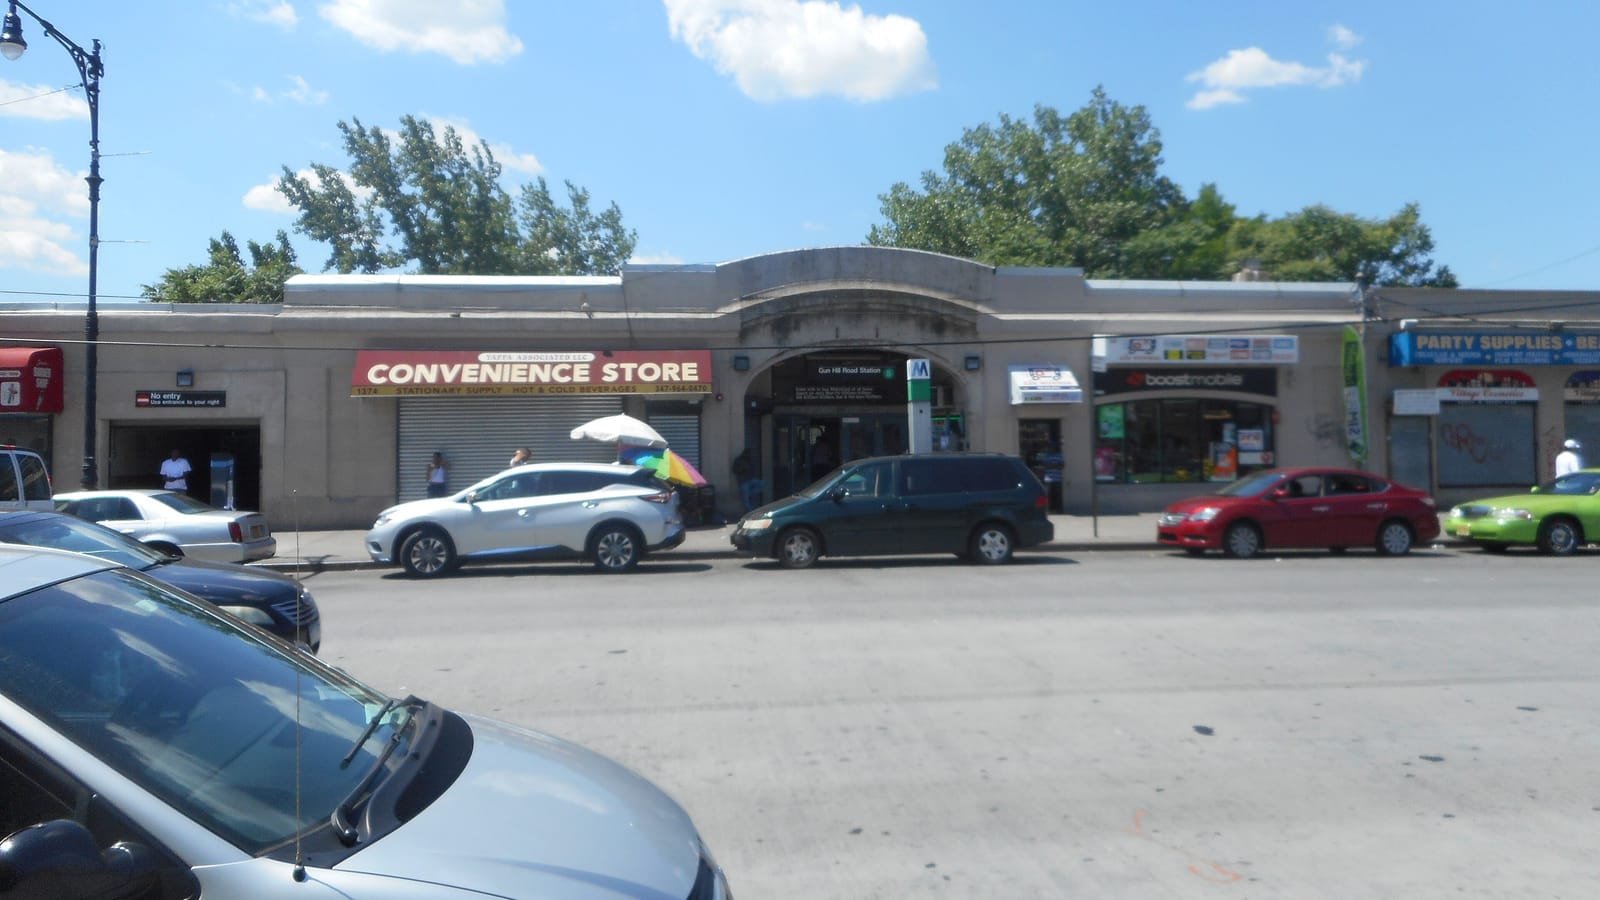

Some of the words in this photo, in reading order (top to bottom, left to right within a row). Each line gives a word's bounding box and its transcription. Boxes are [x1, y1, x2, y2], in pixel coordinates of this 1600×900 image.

[1416, 335, 1475, 350] PARTY
[1480, 335, 1563, 350] SUPPLIES
[1576, 335, 1600, 350] BE
[367, 363, 591, 384] CONVENIENCE
[601, 362, 699, 382] STORE
[397, 387, 461, 395] STATIONARY
[466, 387, 503, 395] SUPPLY
[512, 386, 536, 394] HOT
[579, 385, 637, 393] BEVERAGES
[150, 392, 161, 400] No
[163, 393, 181, 401] entry
